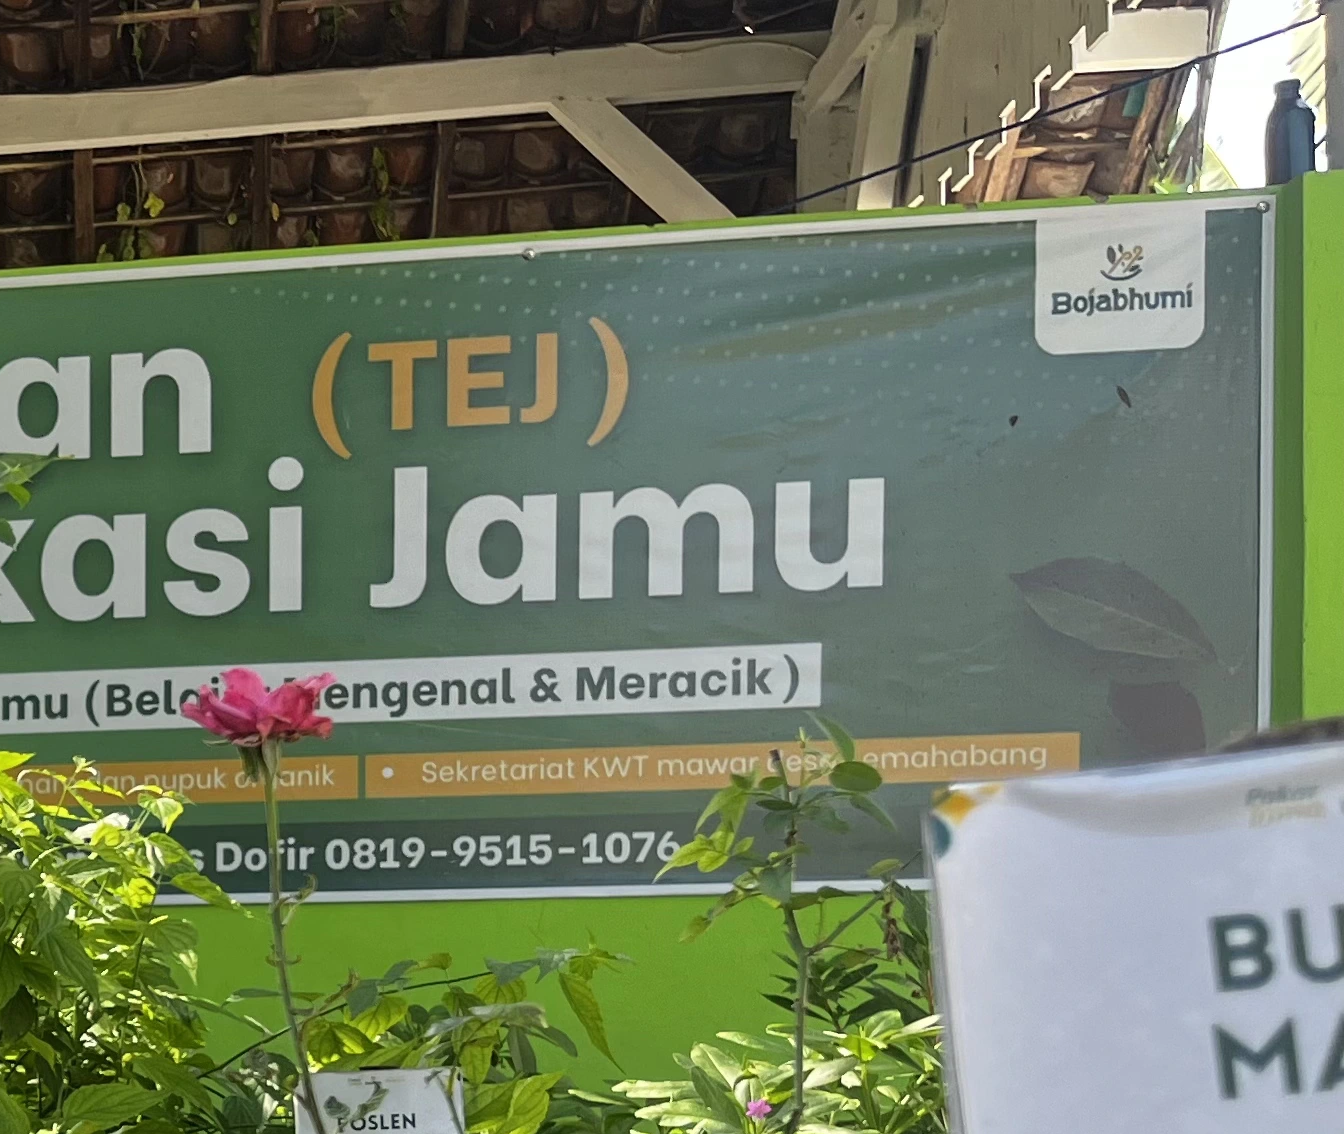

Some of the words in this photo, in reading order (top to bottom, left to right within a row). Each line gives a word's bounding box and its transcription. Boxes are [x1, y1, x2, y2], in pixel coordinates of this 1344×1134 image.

[1051, 282, 1194, 317] Bojabhumi
[369, 464, 885, 608] Jamu
[85, 676, 269, 727] (Bela
[284, 667, 515, 718] engenal
[529, 666, 563, 703] &
[575, 657, 773, 702] Meracik
[234, 764, 336, 789] oanik
[420, 757, 578, 784] Sekretariat
[583, 755, 650, 779] KWT
[657, 755, 759, 777] mawar
[862, 743, 1048, 772] emahabang
[324, 830, 681, 870] 0819-9515-1076
